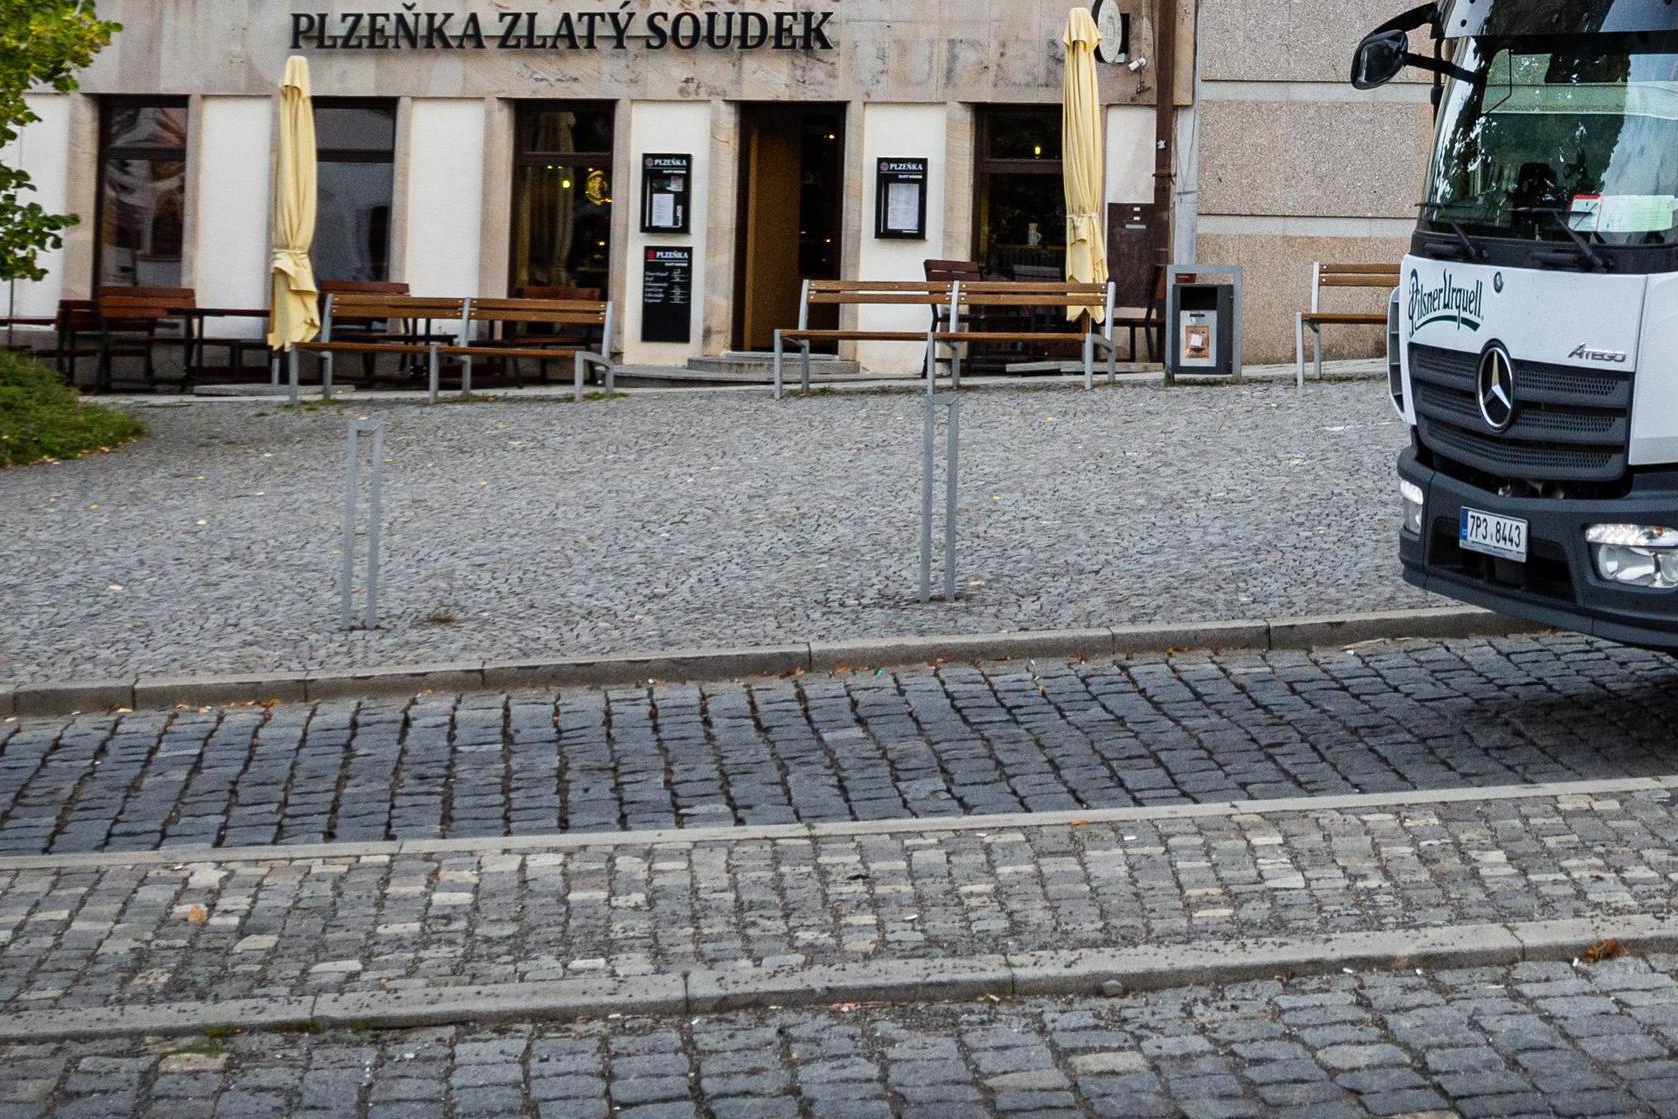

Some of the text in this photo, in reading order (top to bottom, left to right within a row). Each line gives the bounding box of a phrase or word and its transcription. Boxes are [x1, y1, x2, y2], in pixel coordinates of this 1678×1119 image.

[290, 0, 834, 50] PLZEŇKA ZLATÝ SOUDEK
[1407, 268, 1444, 338] Pilsner
[1469, 514, 1521, 548] 7P3 8443
